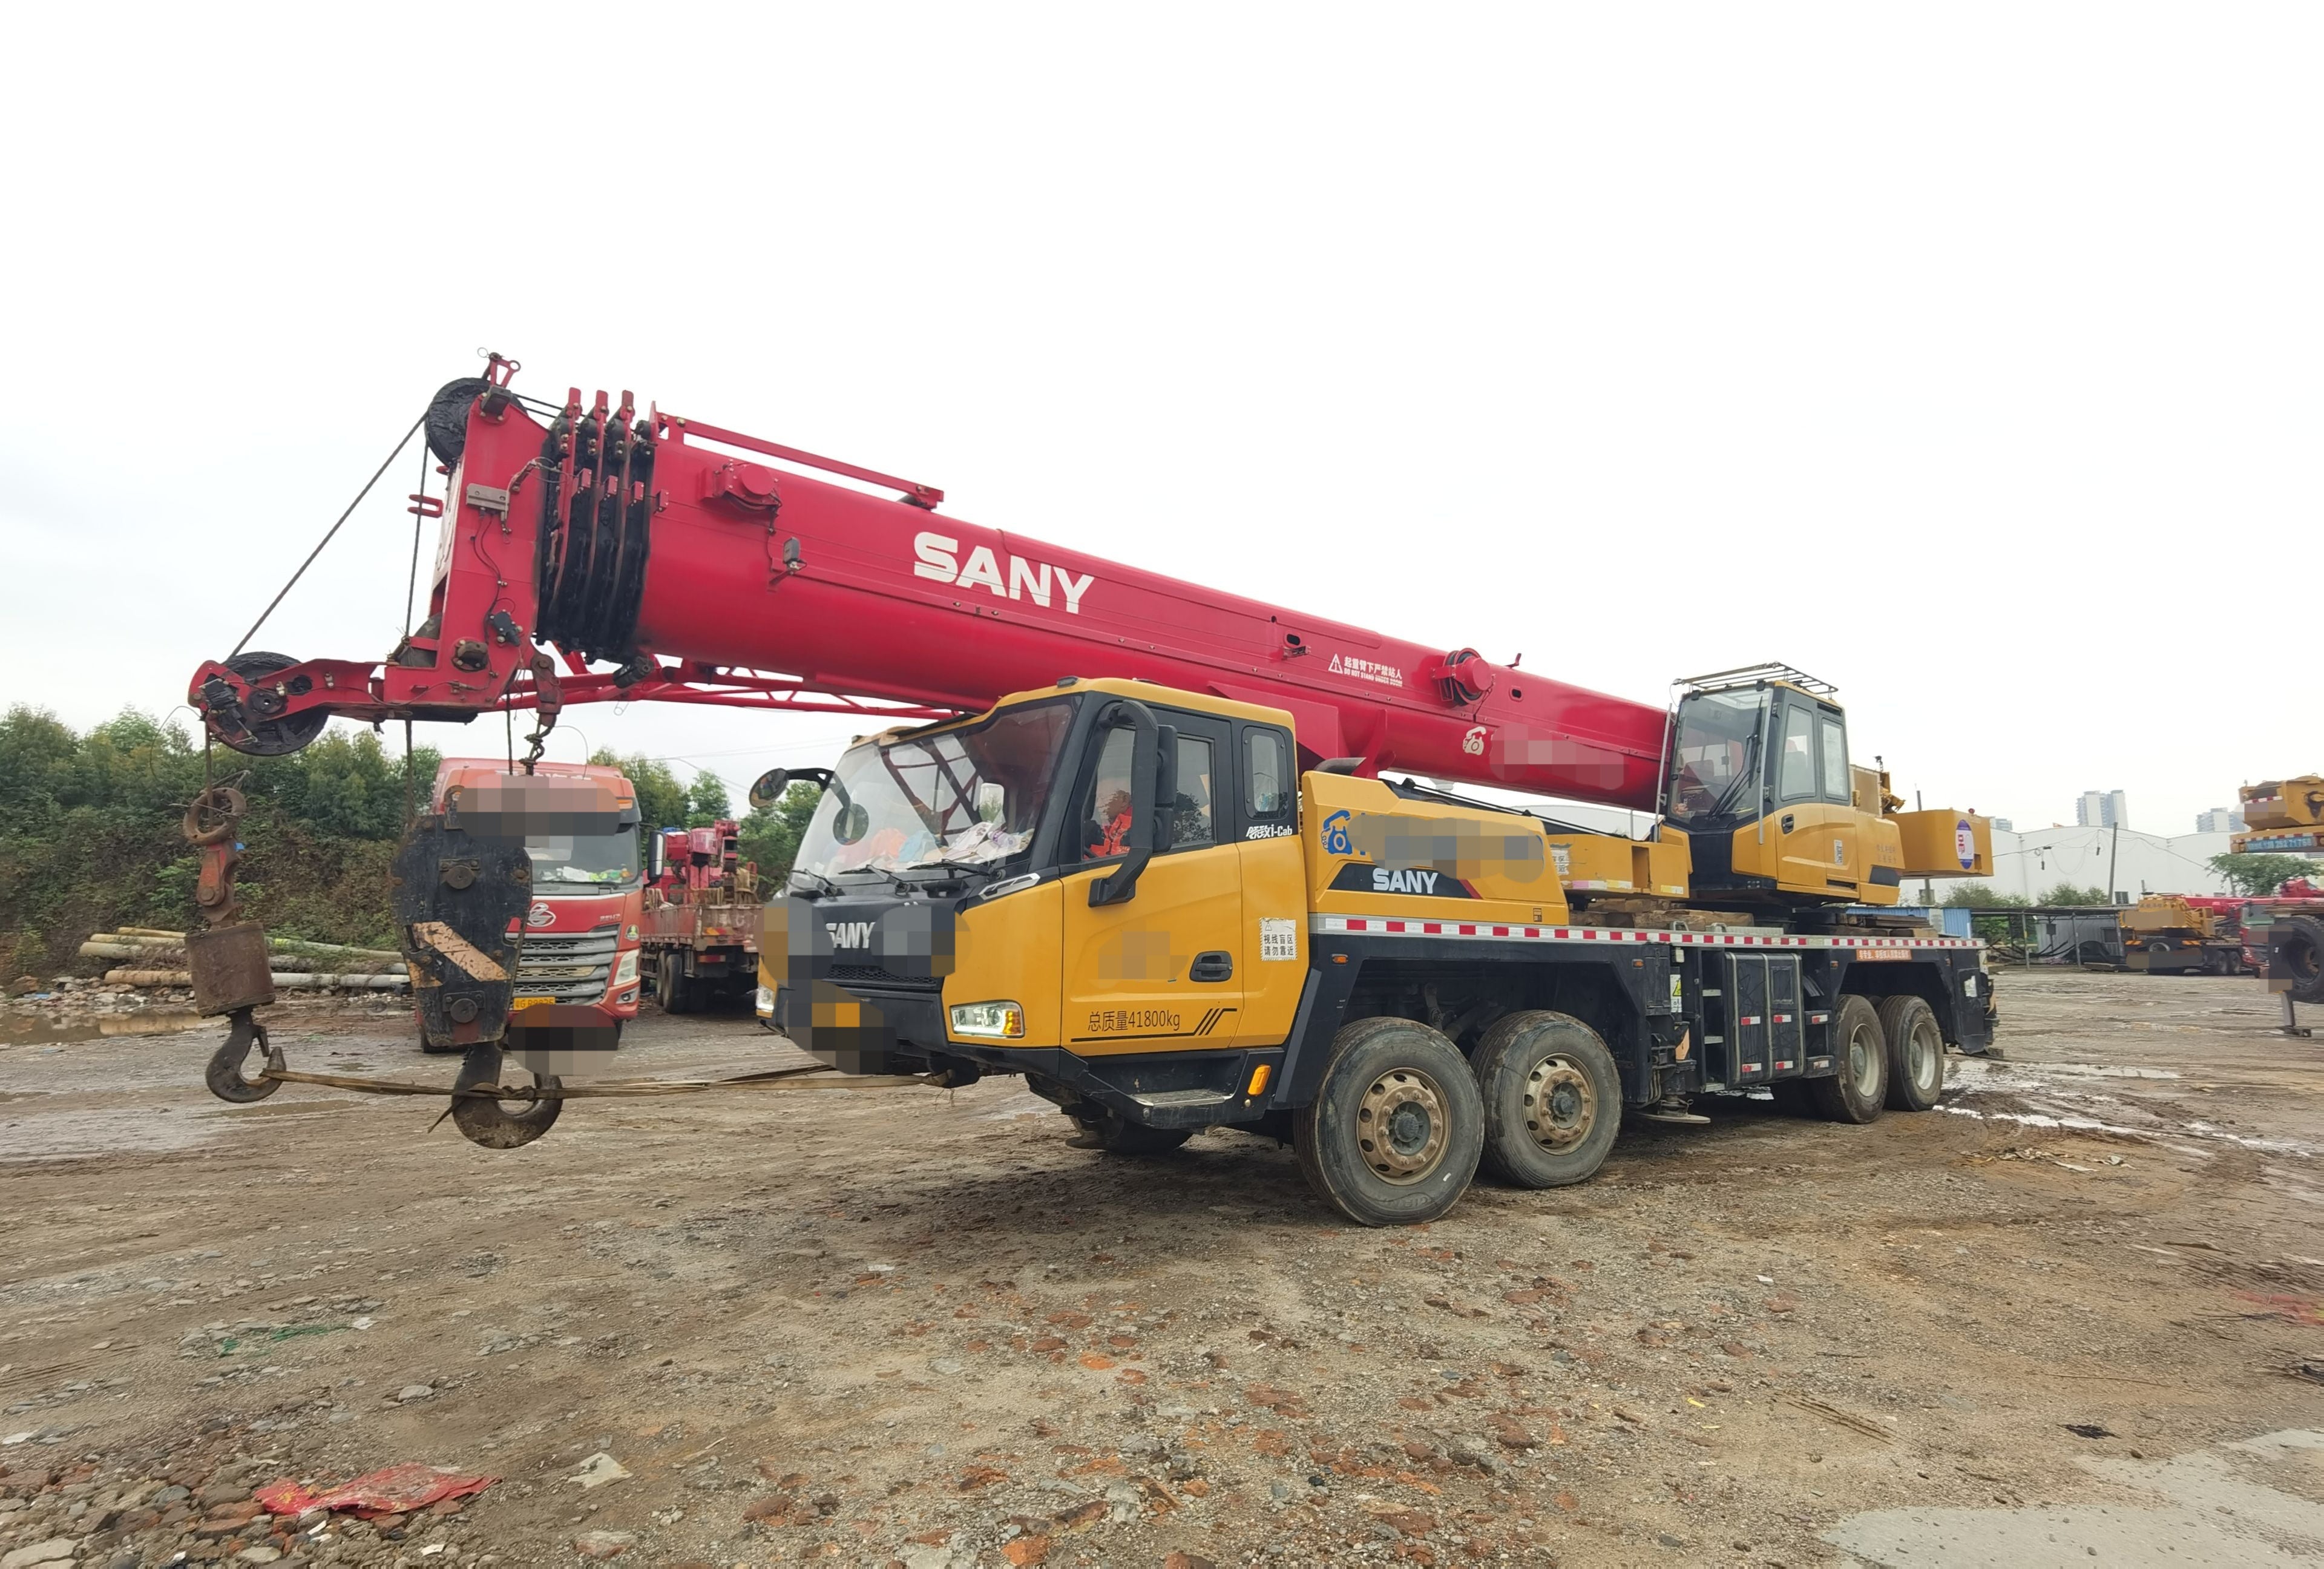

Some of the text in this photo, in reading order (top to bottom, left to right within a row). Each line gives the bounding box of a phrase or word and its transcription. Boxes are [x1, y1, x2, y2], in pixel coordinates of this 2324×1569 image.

[914, 531, 1095, 614] SANY
[1344, 656, 1402, 679] 起重臂下严禁站人
[1351, 669, 1361, 677] NOT
[1361, 672, 1374, 681] STAND
[1373, 867, 1438, 894] SANY
[1264, 934, 1293, 944] 视线盲区
[1264, 946, 1294, 956] 请勿靠近
[1088, 1010, 1180, 1031] 总质量41800kg
